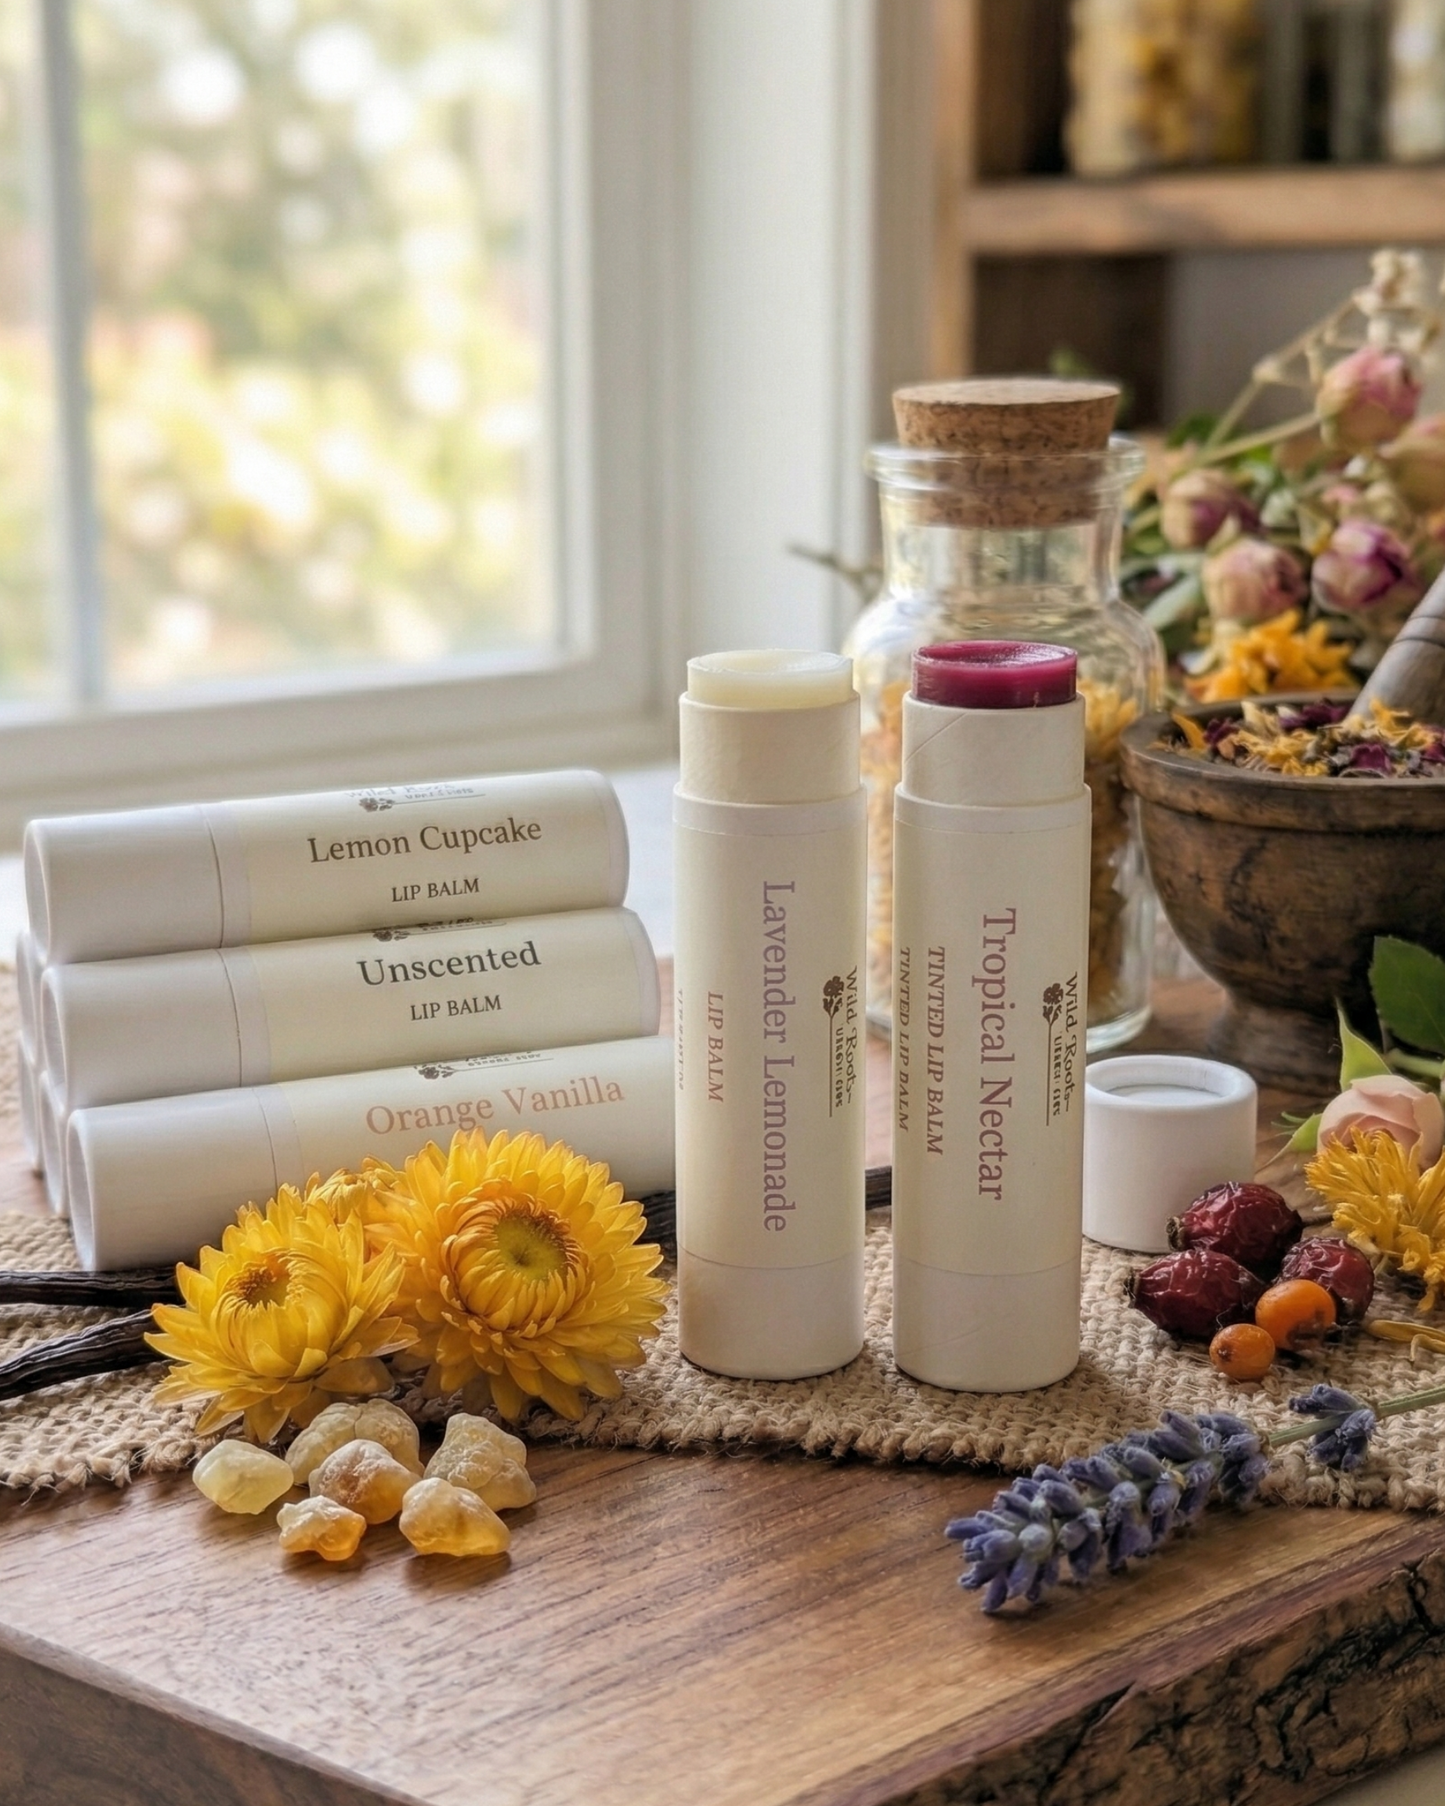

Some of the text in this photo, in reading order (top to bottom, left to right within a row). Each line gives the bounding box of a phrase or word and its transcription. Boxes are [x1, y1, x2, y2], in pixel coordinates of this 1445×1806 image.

[308, 816, 542, 865] Lemon Cupcake
[391, 877, 480, 903] LIP BALM
[356, 940, 541, 986] Unscented
[899, 947, 910, 1026] TINTED
[410, 994, 502, 1021] LIP BALM
[845, 966, 858, 1025] Wild
[1064, 971, 1078, 1033] Wild
[707, 991, 724, 1103] LIP BALM
[763, 881, 796, 1232] Lavender Lemonade
[899, 1035, 910, 1066] LIP
[927, 946, 945, 1155] TINTED LIP BALM
[972, 907, 1017, 1201] Tropical Nectar
[365, 1075, 625, 1135] Orange Vanilla
